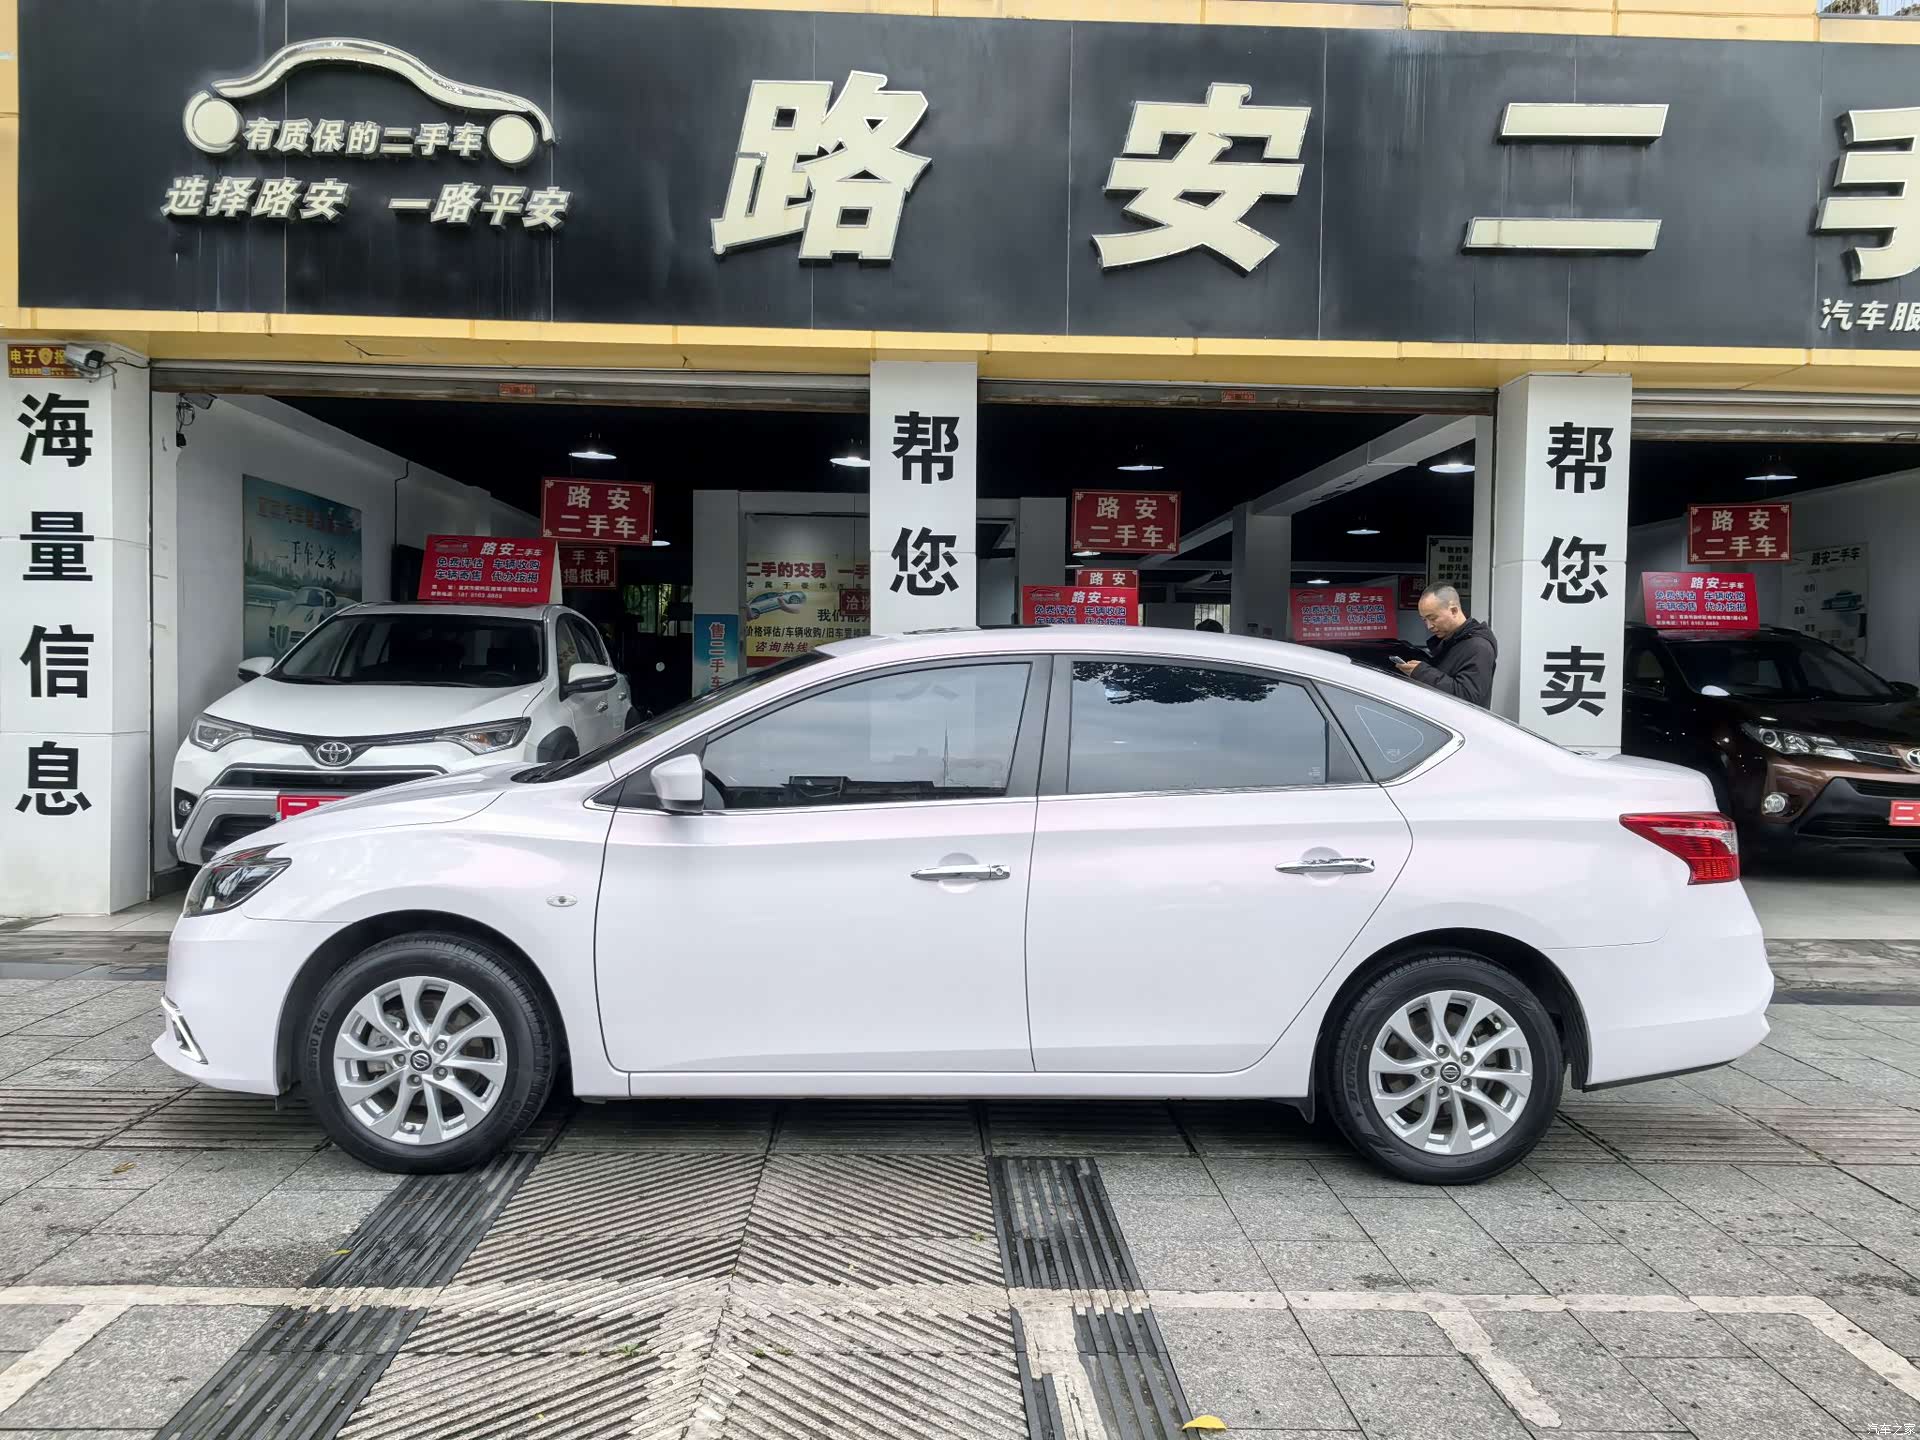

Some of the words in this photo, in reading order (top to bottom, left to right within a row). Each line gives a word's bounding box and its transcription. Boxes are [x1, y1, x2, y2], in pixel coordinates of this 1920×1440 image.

[243, 118, 485, 158] 有质保的二手车
[162, 175, 349, 223] 选择路安
[387, 182, 573, 231] 一路平安
[566, 485, 632, 511] 路安
[889, 410, 960, 596] 帮您
[1096, 496, 1158, 520] 路安
[558, 514, 637, 539] 二手车
[1711, 509, 1771, 532] 路安
[1088, 524, 1164, 547] 二手车
[1704, 535, 1777, 557] 二手车
[479, 541, 544, 558] 路安二手车
[746, 562, 827, 578] 二手的交易
[1089, 571, 1126, 586] 路安
[1540, 421, 1615, 718] 帮您卖
[1690, 577, 1745, 590] 路安二手车
[15, 392, 95, 817] 海量信息
[1071, 591, 1127, 604] 路安二手车
[755, 641, 809, 654] 咨询热线
